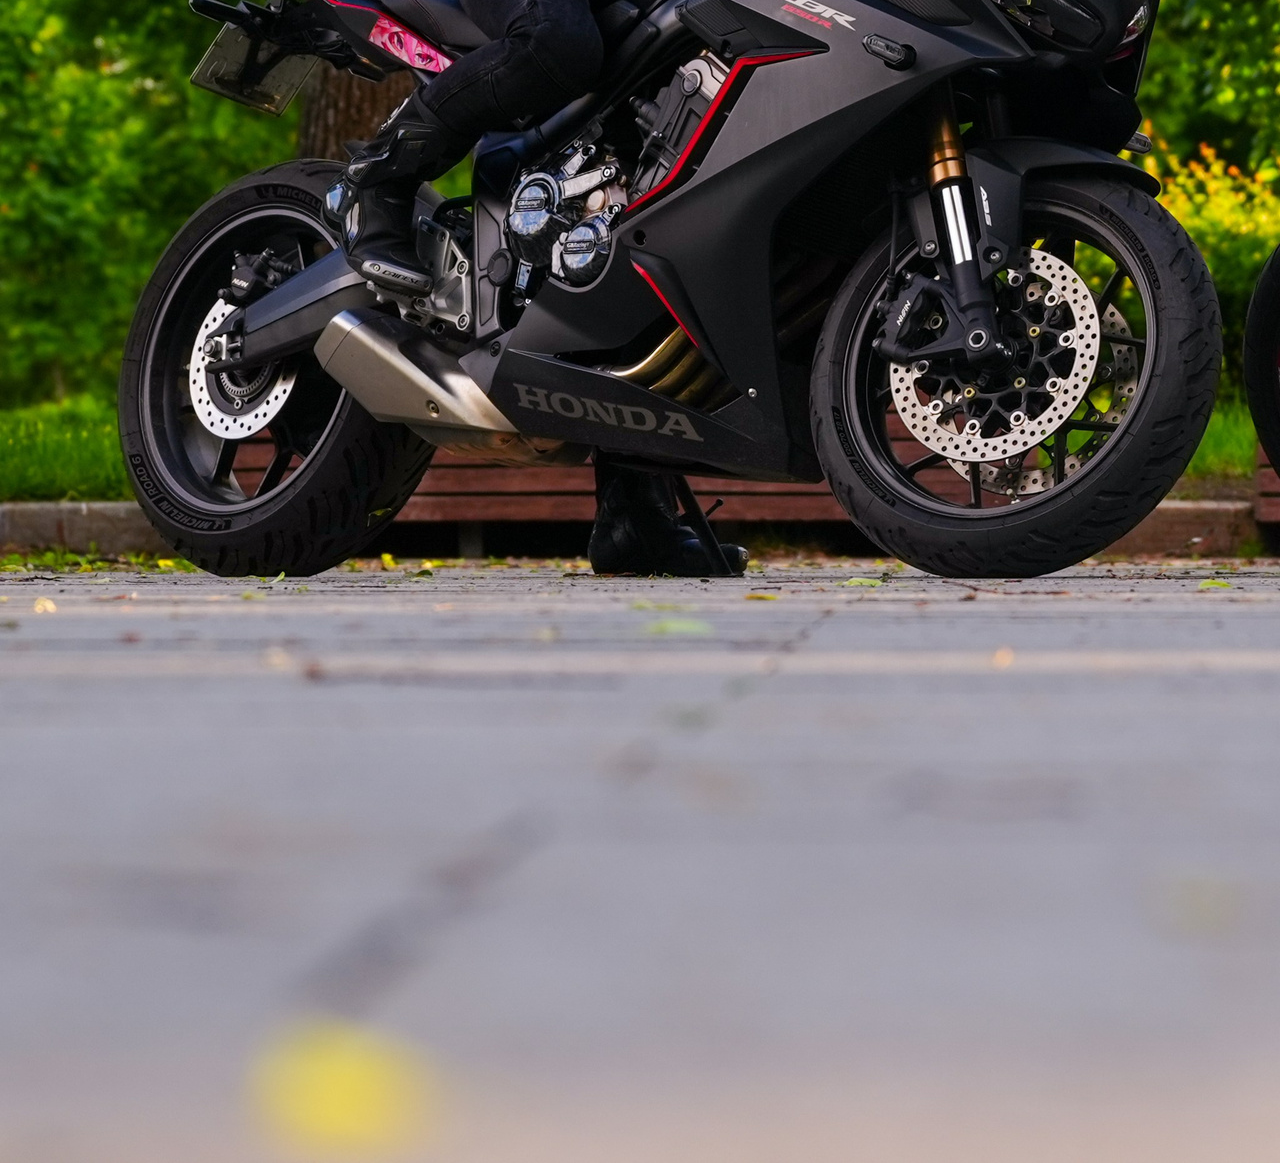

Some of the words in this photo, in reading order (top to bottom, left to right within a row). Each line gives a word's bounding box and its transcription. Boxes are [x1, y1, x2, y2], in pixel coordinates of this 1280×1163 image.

[1110, 214, 1143, 251] MICHELIN
[1144, 256, 1158, 279] ROAD
[513, 383, 704, 442] HONDA
[135, 467, 159, 498] ROAD
[852, 460, 886, 498] MICHELIN
[157, 500, 212, 530] MICHELIN
